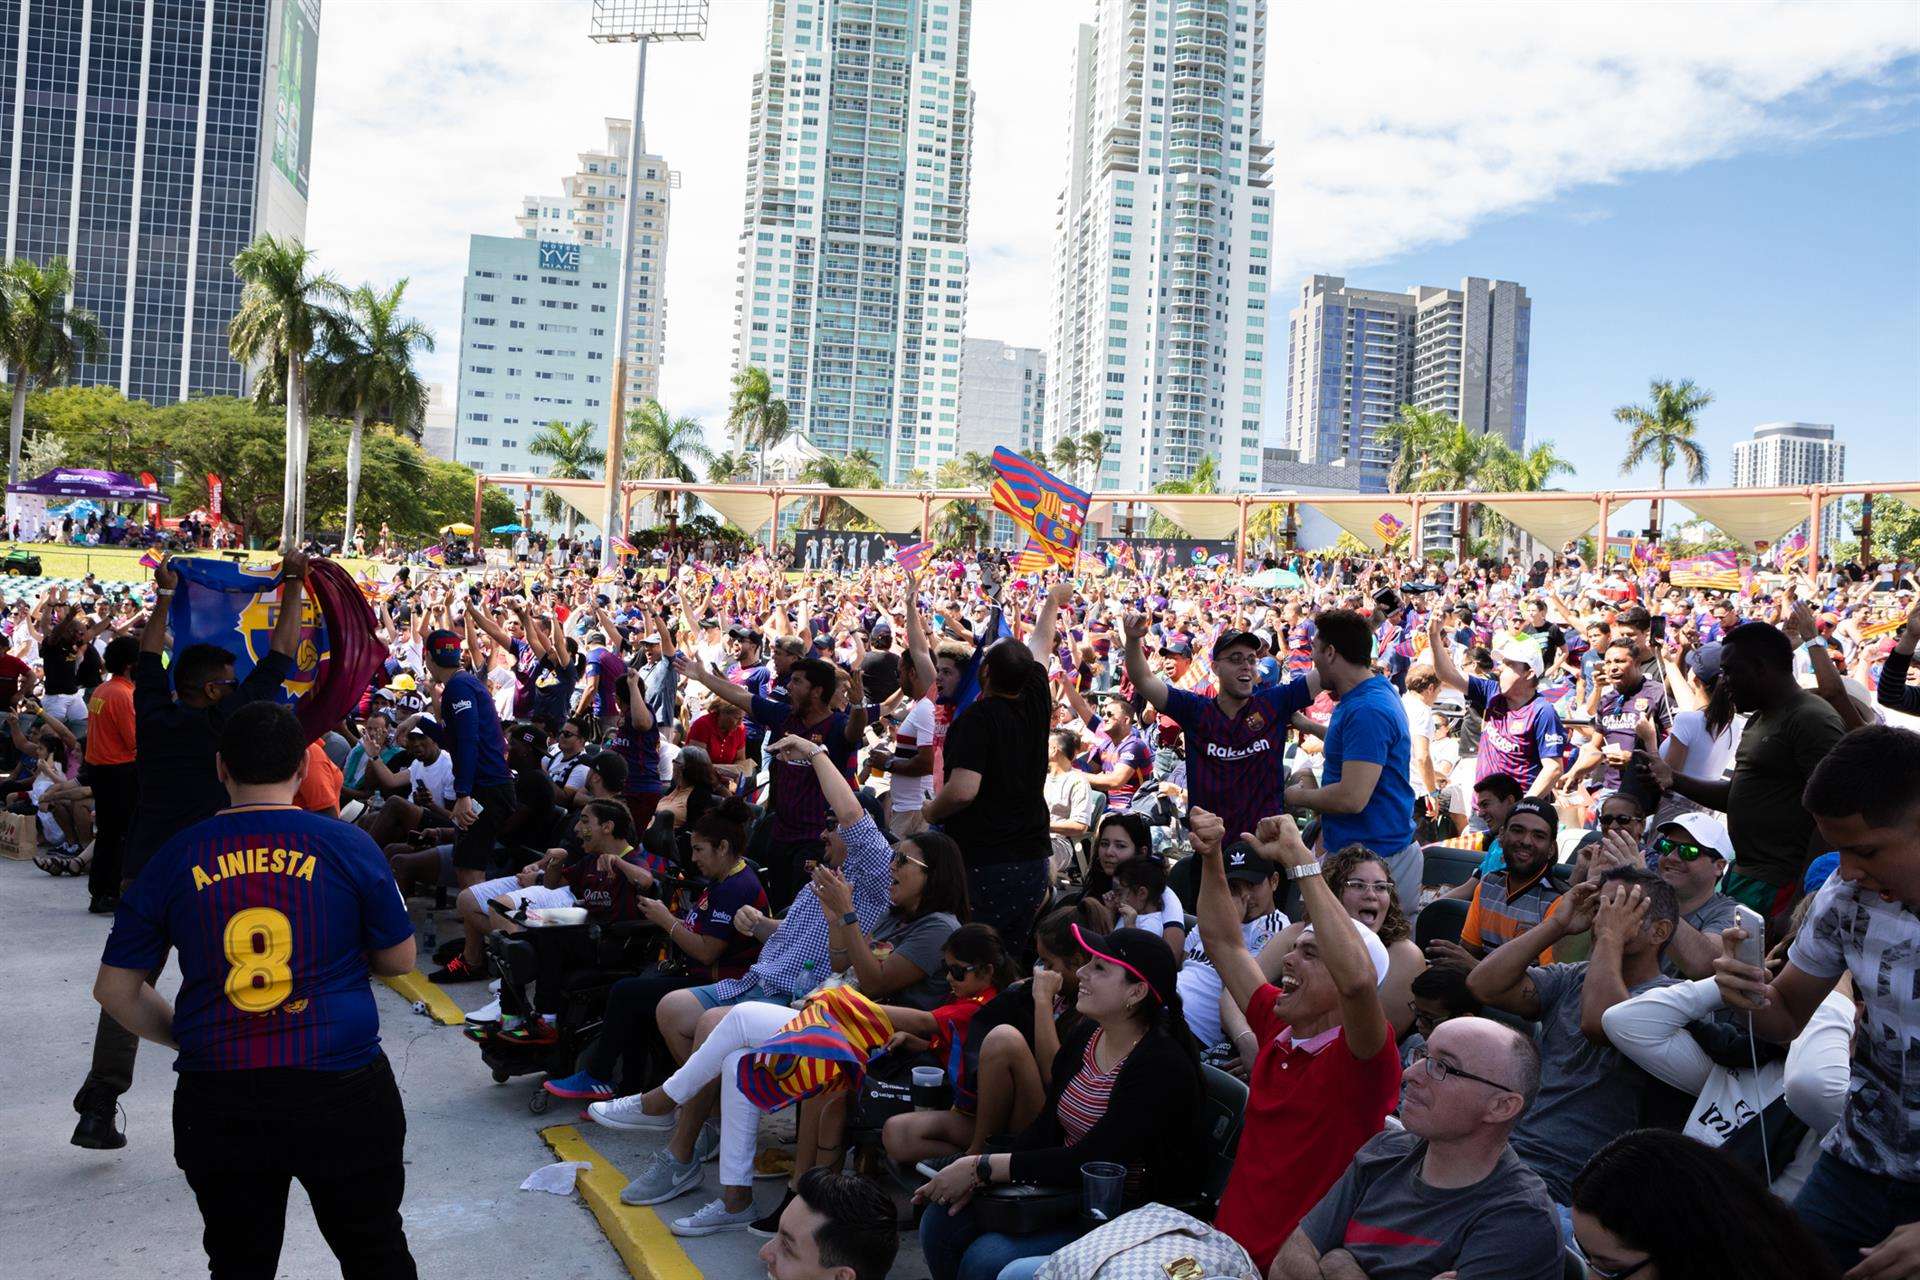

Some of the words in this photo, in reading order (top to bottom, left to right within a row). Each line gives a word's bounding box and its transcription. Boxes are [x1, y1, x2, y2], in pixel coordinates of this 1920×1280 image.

[542, 243, 578, 252] HOTEL
[540, 248, 580, 265] YVE
[542, 263, 577, 271] MIAMI
[452, 699, 472, 710] beko
[1207, 739, 1270, 758] Rakuten
[192, 848, 317, 891] A.INIESTA
[712, 909, 732, 922] beko
[223, 906, 293, 1013] 8
